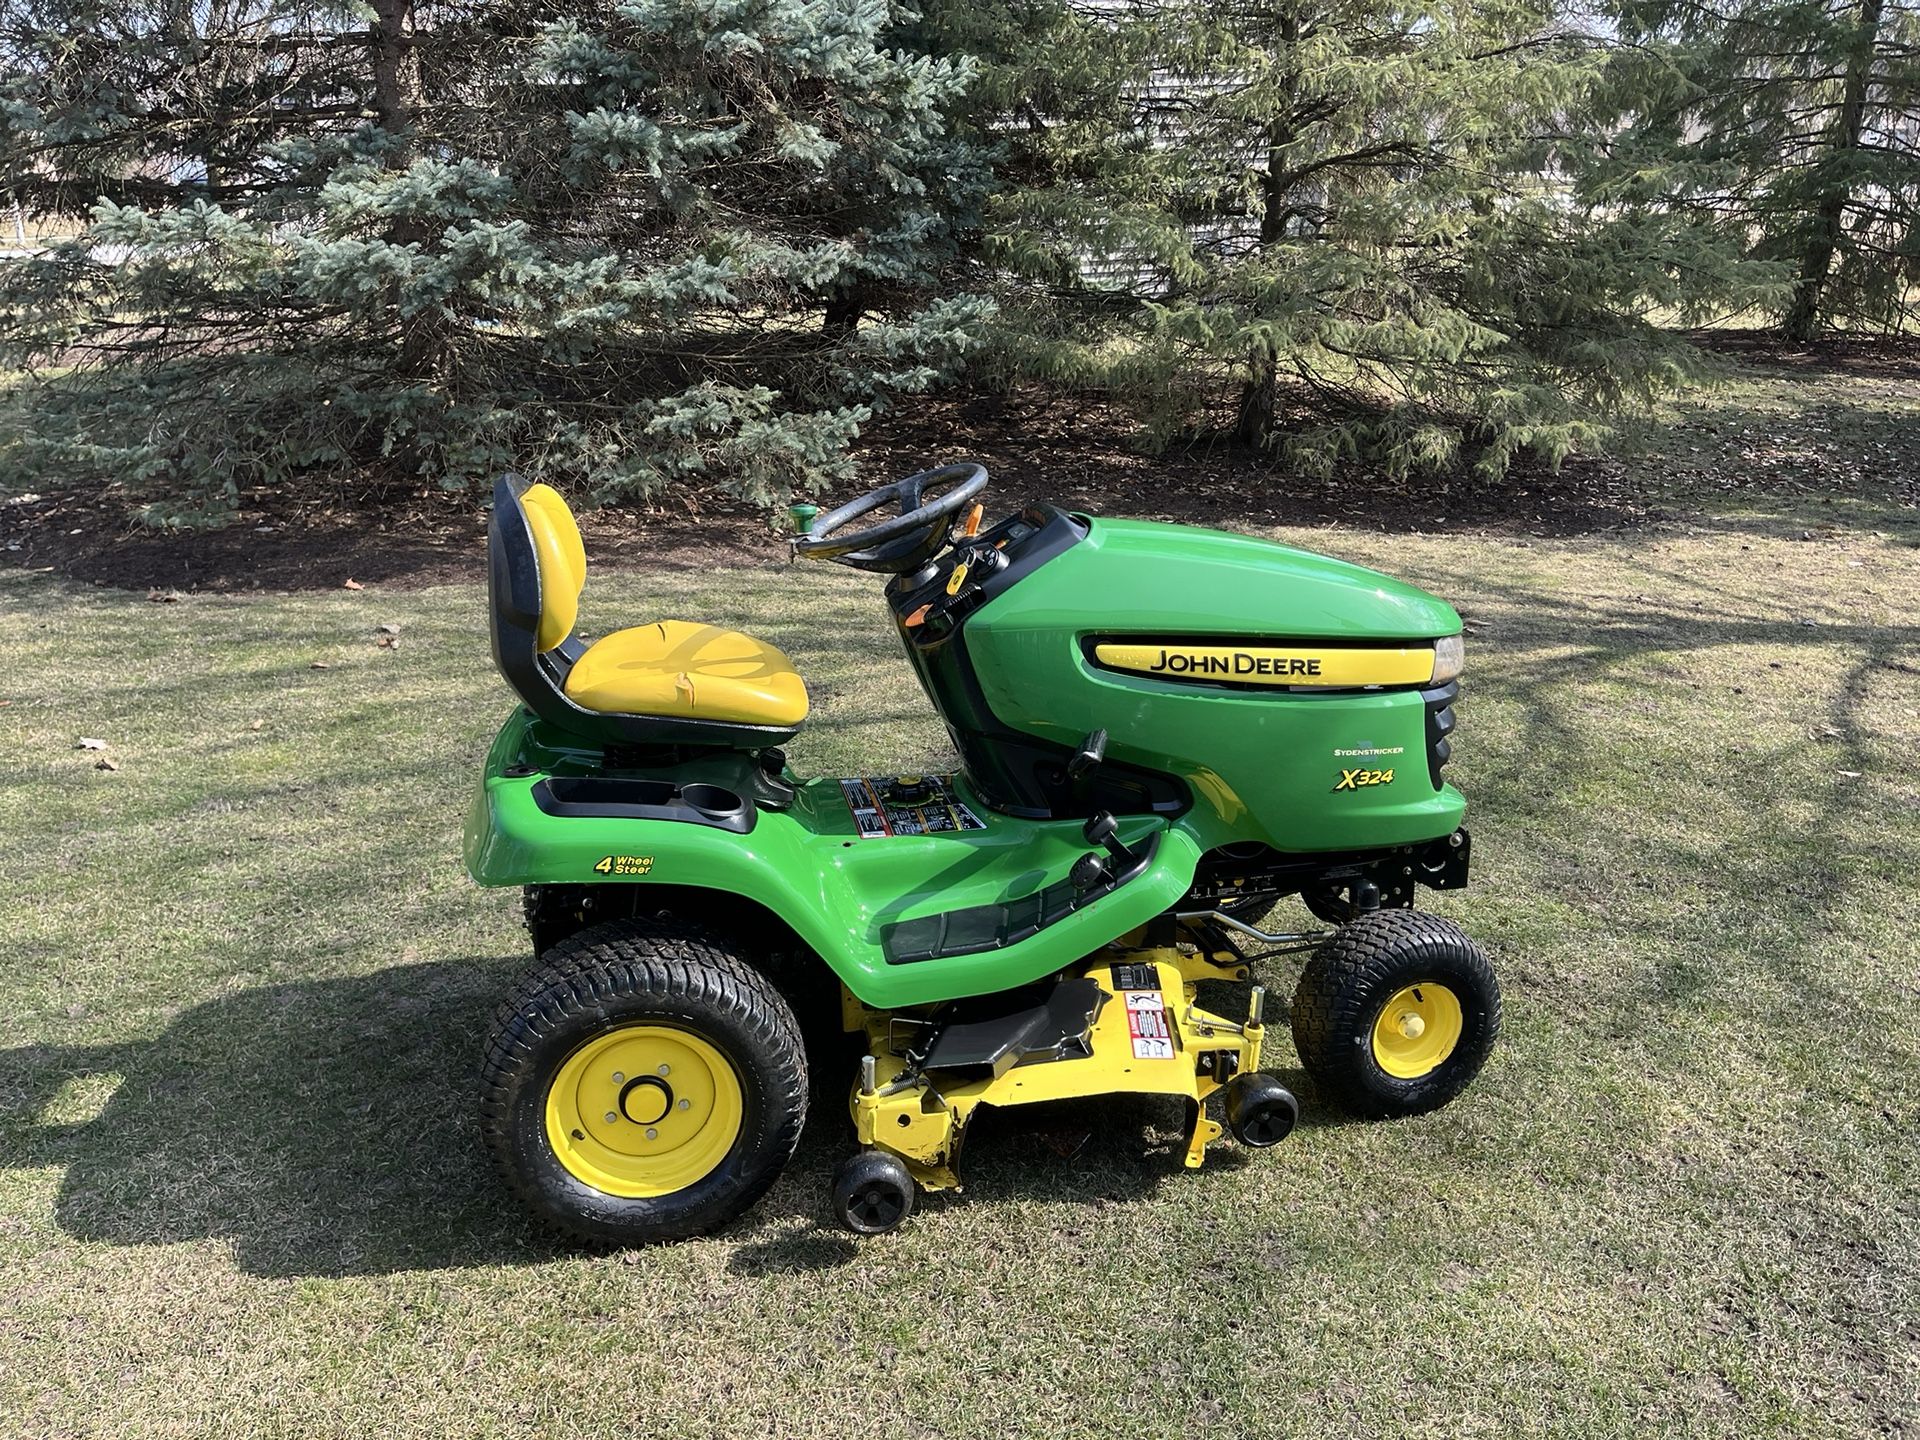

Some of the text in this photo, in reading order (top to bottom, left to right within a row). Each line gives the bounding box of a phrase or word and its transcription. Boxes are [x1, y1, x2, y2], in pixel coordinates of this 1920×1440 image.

[1150, 650, 1321, 675] JOHN DEERE
[1333, 747, 1404, 757] SYDENSTRICKER
[1334, 769, 1395, 790] X324
[594, 856, 654, 873] 4 Wheel
[614, 865, 651, 874] Steer
